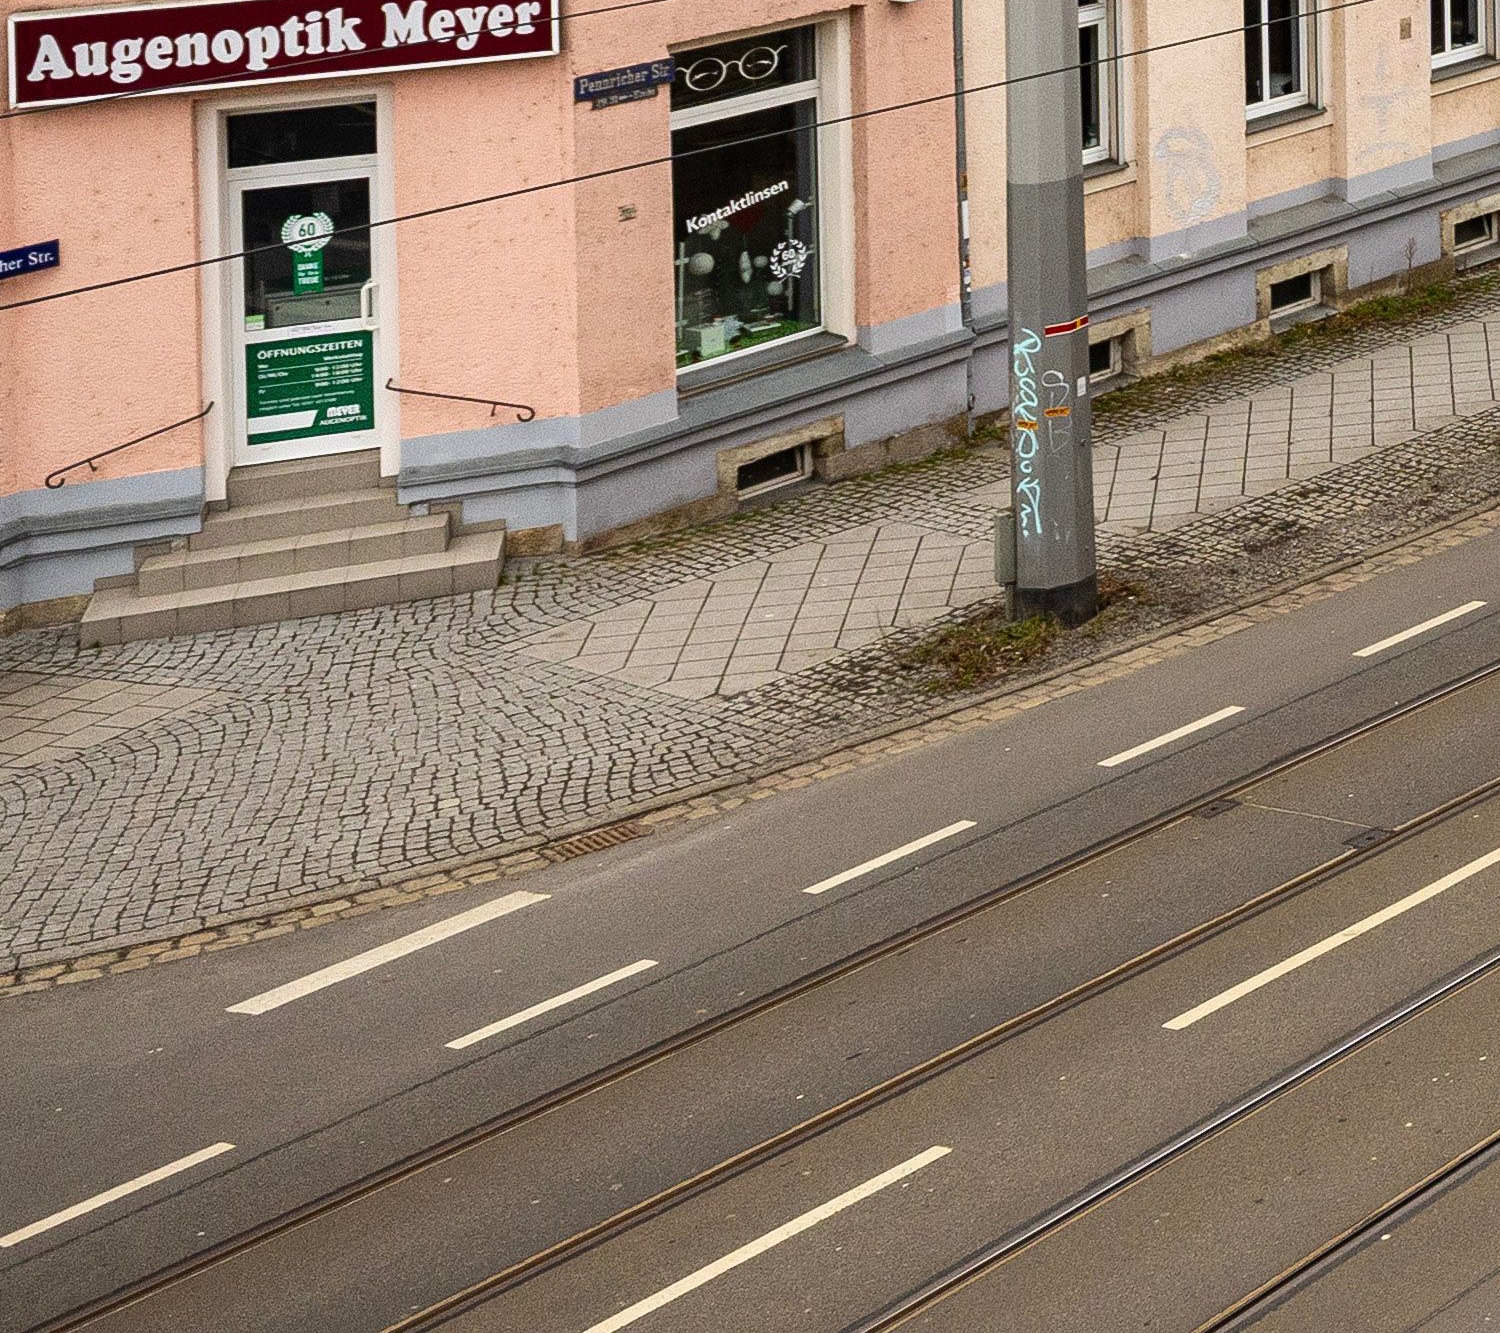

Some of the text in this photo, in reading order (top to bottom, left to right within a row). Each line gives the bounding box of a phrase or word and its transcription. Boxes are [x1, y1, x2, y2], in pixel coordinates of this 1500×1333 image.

[27, 0, 541, 84] Augenoptik Meyer
[579, 69, 649, 95] Pennricher
[685, 180, 790, 233] Kontaktlinsen
[298, 222, 316, 237] 60
[0, 251, 55, 273] her Str.
